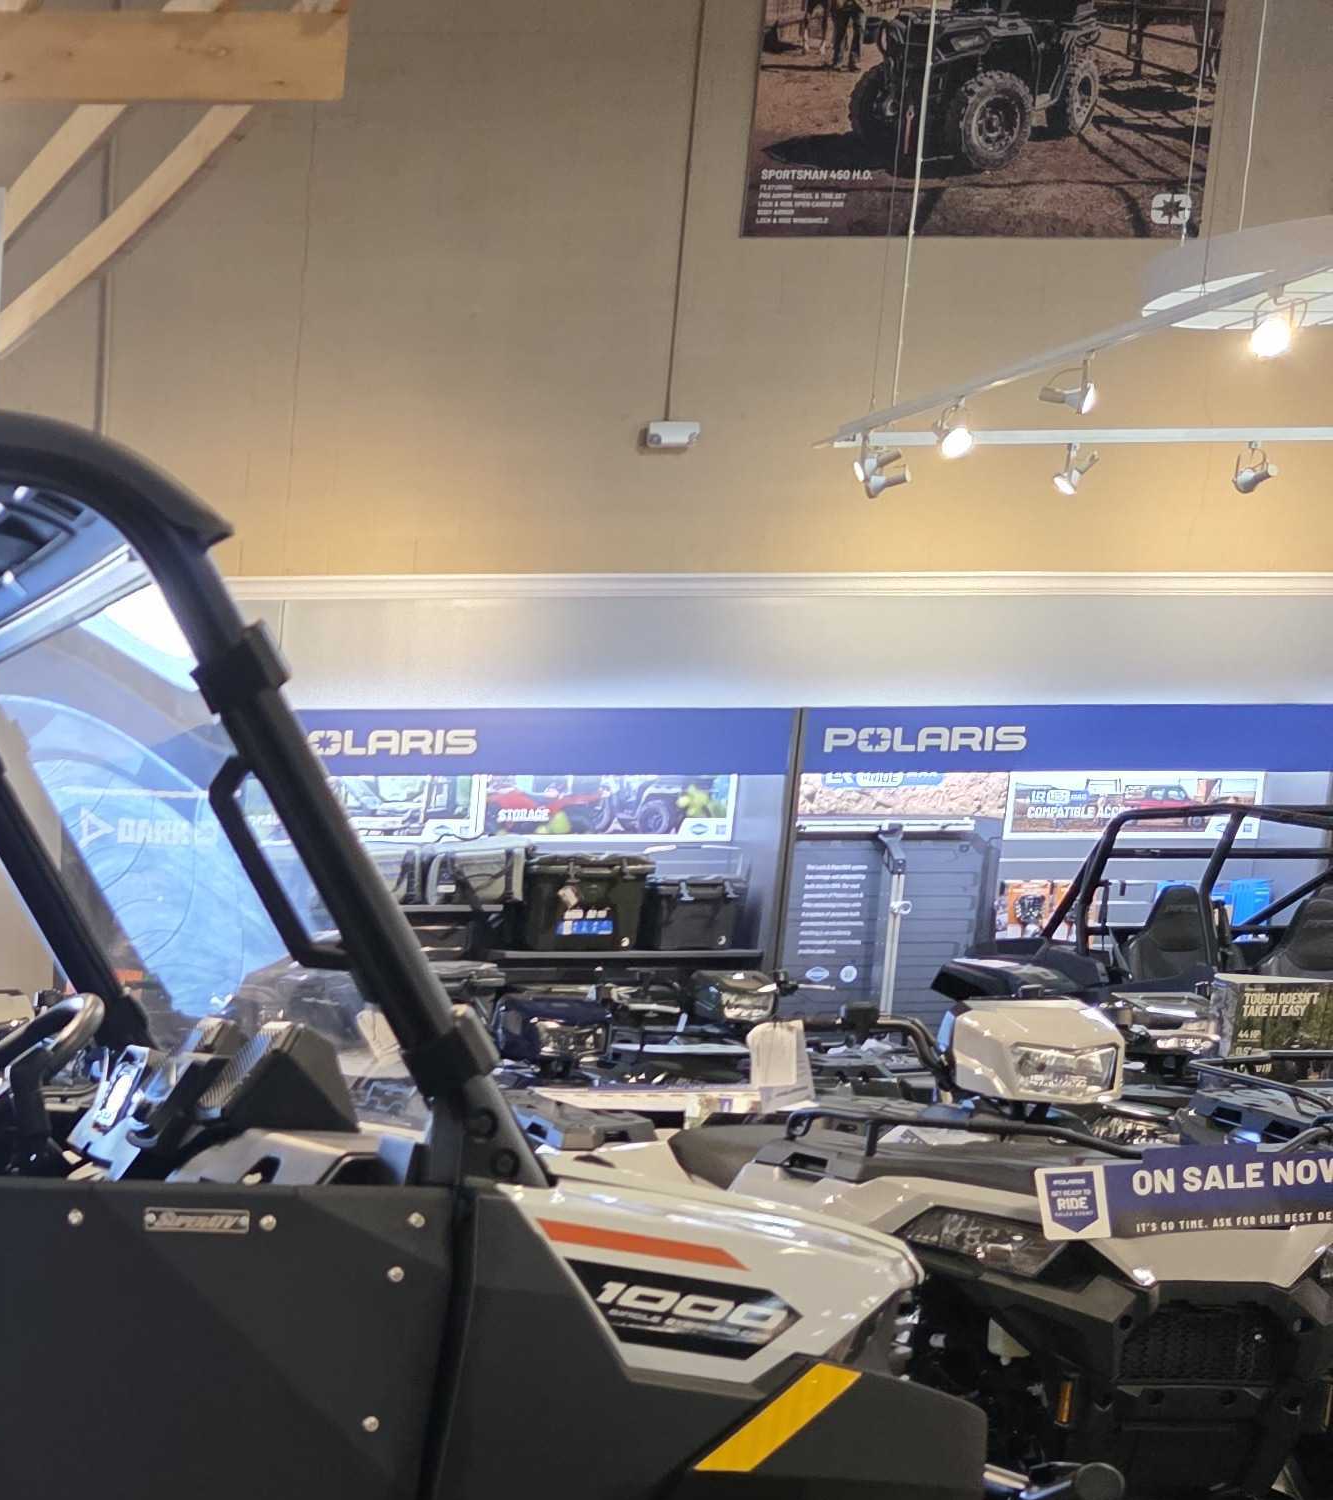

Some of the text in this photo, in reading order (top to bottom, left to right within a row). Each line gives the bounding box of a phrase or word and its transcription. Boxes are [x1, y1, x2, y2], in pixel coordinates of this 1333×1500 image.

[760, 169, 828, 180] SPORTSMAN
[852, 169, 873, 180] H.O.
[307, 729, 478, 755] OLARIS
[823, 725, 1027, 752] POLARIS
[496, 808, 551, 822] STORAGE
[1027, 806, 1094, 818] COMPATIBLE
[1244, 992, 1320, 1004] TOUGH DOESN'T
[1242, 1005, 1308, 1017] TAKE IT EASY
[1132, 1167, 1176, 1196] ON
[1182, 1162, 1265, 1193] SALE
[1056, 1196, 1089, 1211] RIDE
[1136, 1223, 1157, 1233] IT'S
[1161, 1222, 1175, 1232] GO
[1178, 1220, 1209, 1231] TIME.
[1212, 1218, 1232, 1228] ASK
[1236, 1216, 1256, 1226] FOR
[1259, 1214, 1280, 1225] OUR
[1284, 1212, 1312, 1223] BEST
[595, 1281, 789, 1330] 1000
